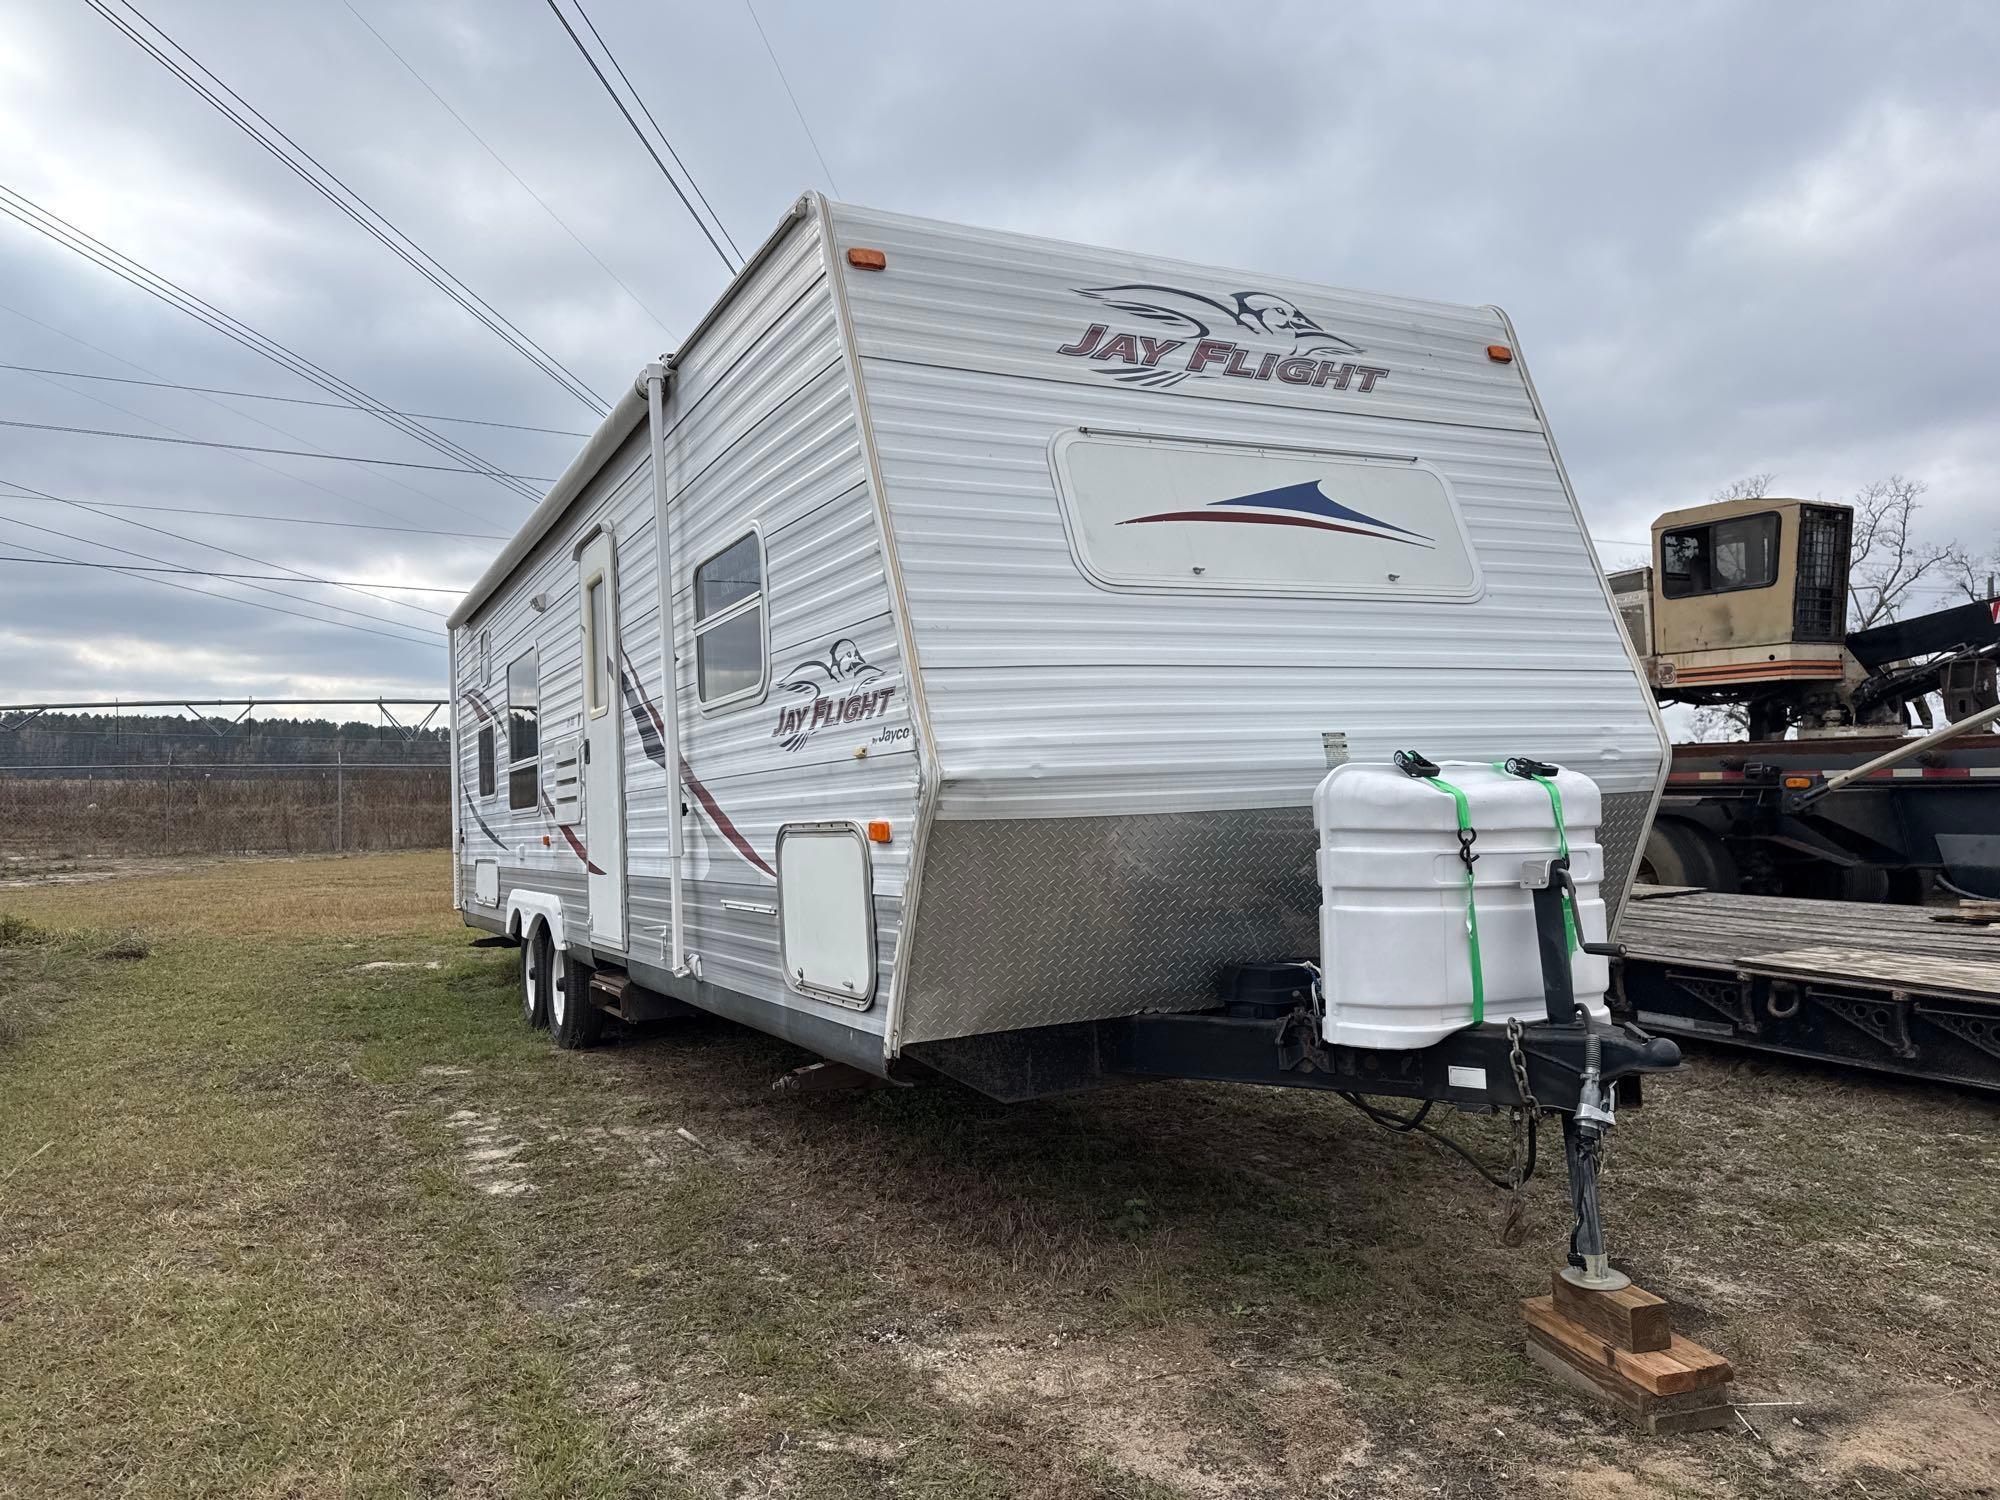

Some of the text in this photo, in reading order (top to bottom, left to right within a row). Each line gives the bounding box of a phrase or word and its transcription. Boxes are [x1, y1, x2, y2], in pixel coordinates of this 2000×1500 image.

[1056, 323, 1390, 393] JAY FLIGHT
[772, 685, 896, 738] JAY FLIGHT
[878, 726, 910, 745] Jayco
